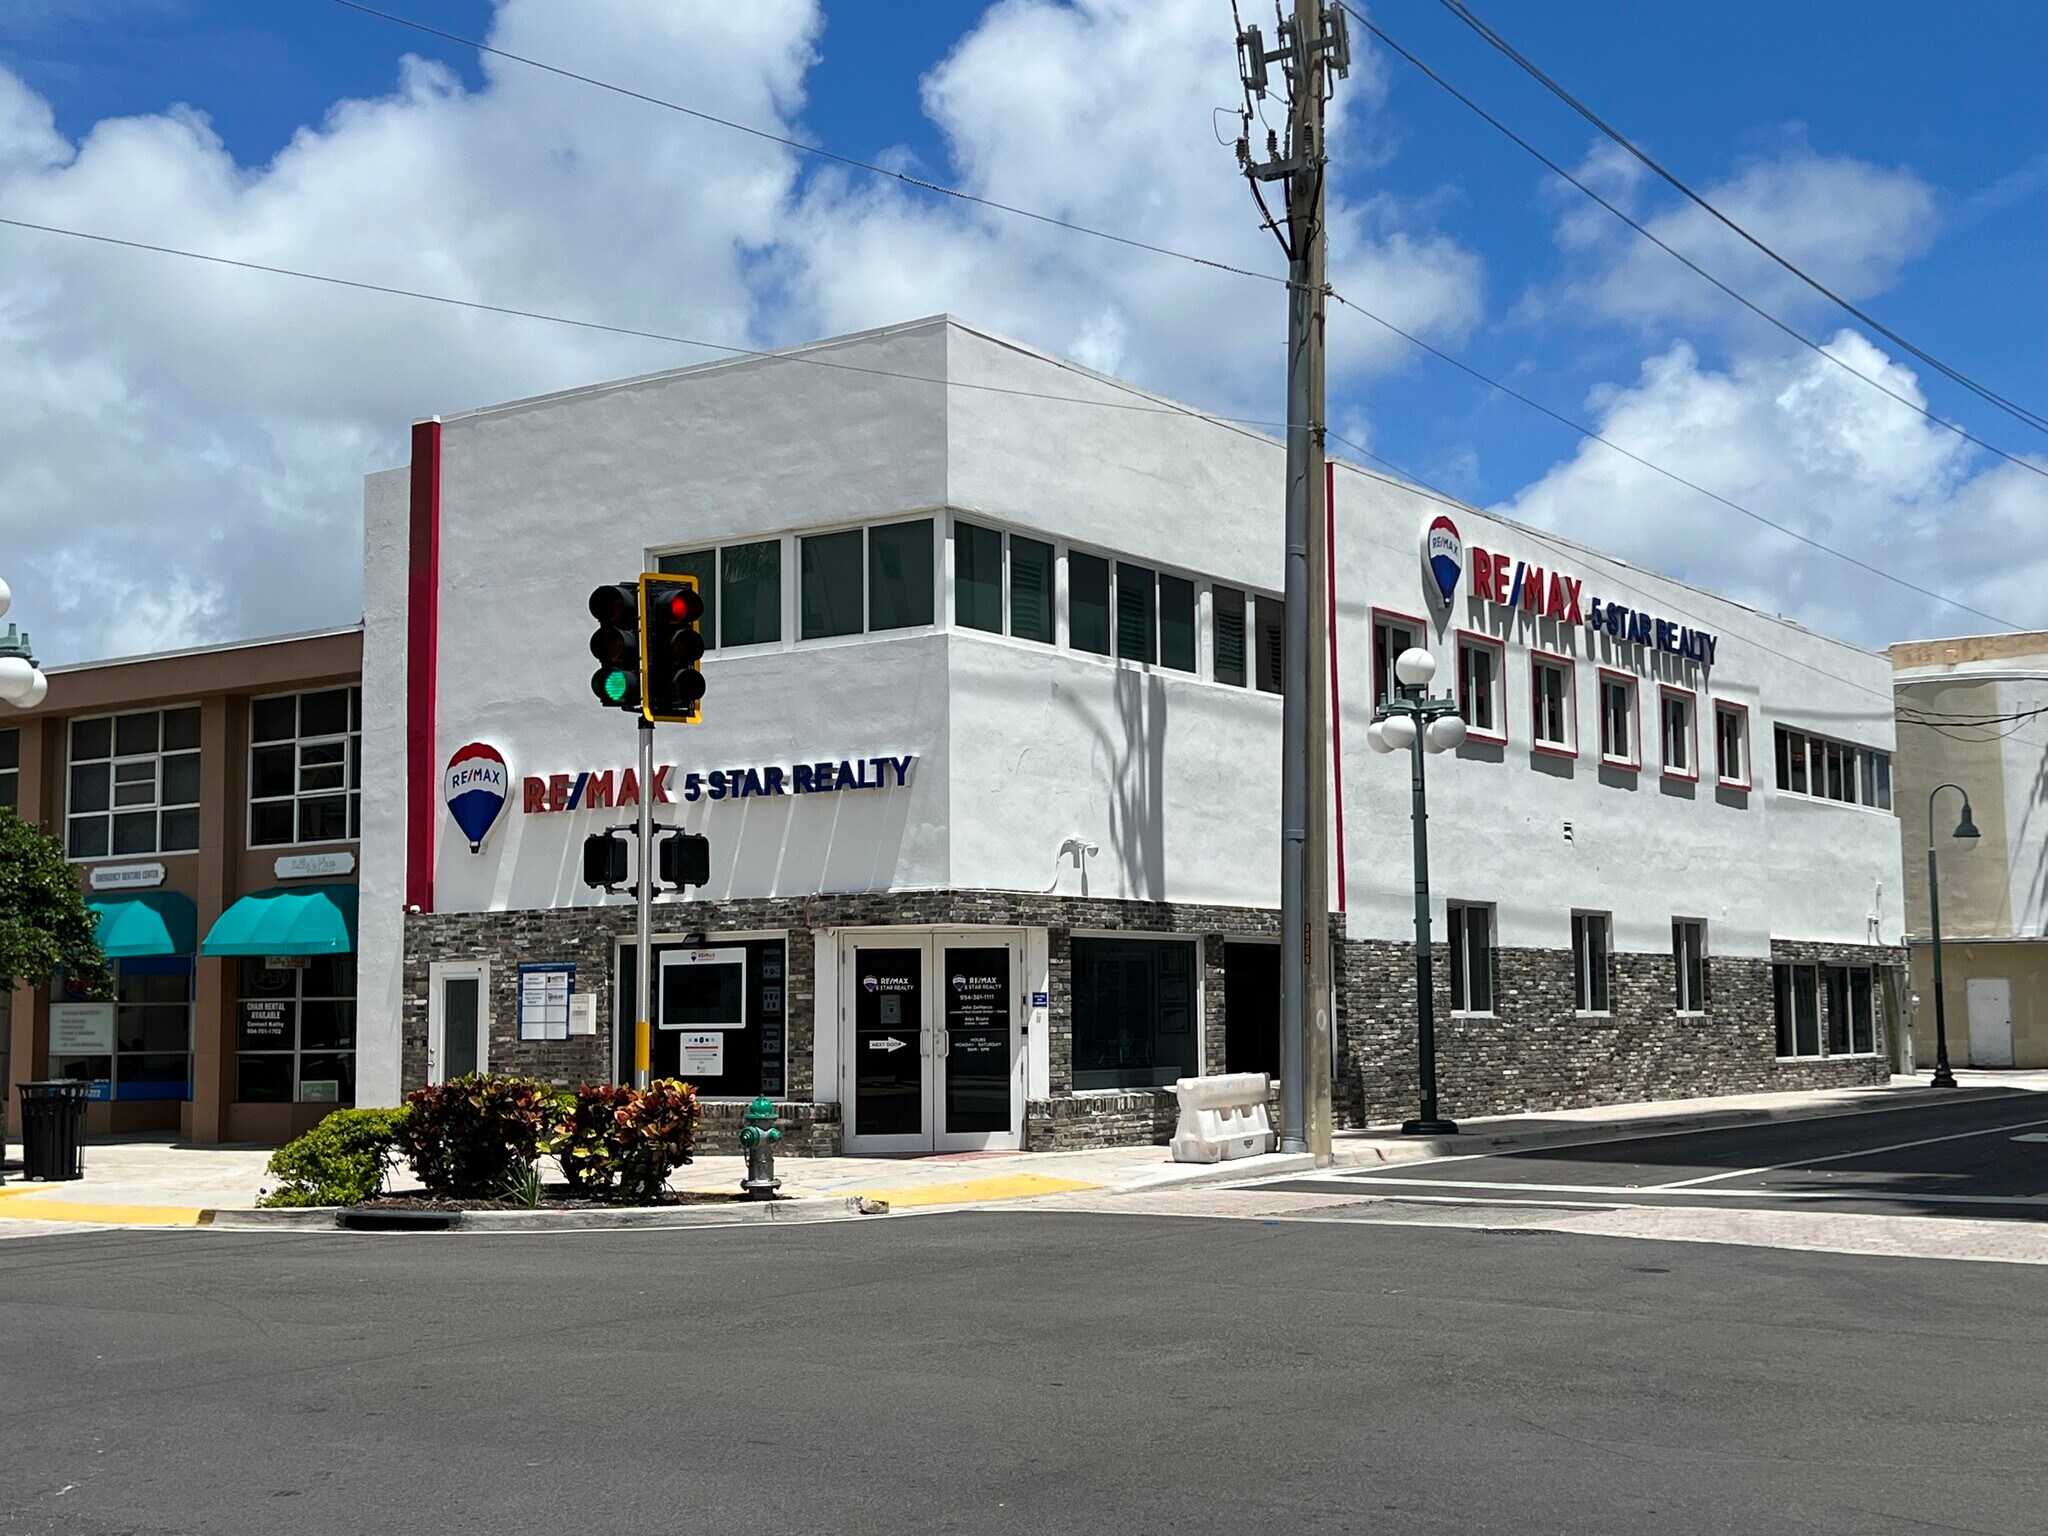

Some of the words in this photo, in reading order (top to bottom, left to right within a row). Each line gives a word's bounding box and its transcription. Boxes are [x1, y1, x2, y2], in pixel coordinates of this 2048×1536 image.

[1432, 537, 1459, 556] RE/MAX
[1472, 546, 1583, 625] RE/MAX
[1591, 597, 1602, 631] 5
[1606, 602, 1653, 647] STAR
[1656, 618, 1718, 666] REALTY
[452, 768, 500, 789] RE/MAX
[523, 765, 671, 814] RE/MAX
[685, 773, 702, 802] 5
[707, 766, 786, 800] STAR
[792, 755, 914, 795] REALTY
[142, 869, 159, 879] CENTER
[247, 1003, 264, 1011] CHAIR
[264, 1003, 286, 1011] RENTAL
[251, 1011, 281, 1019] AVAILABLE
